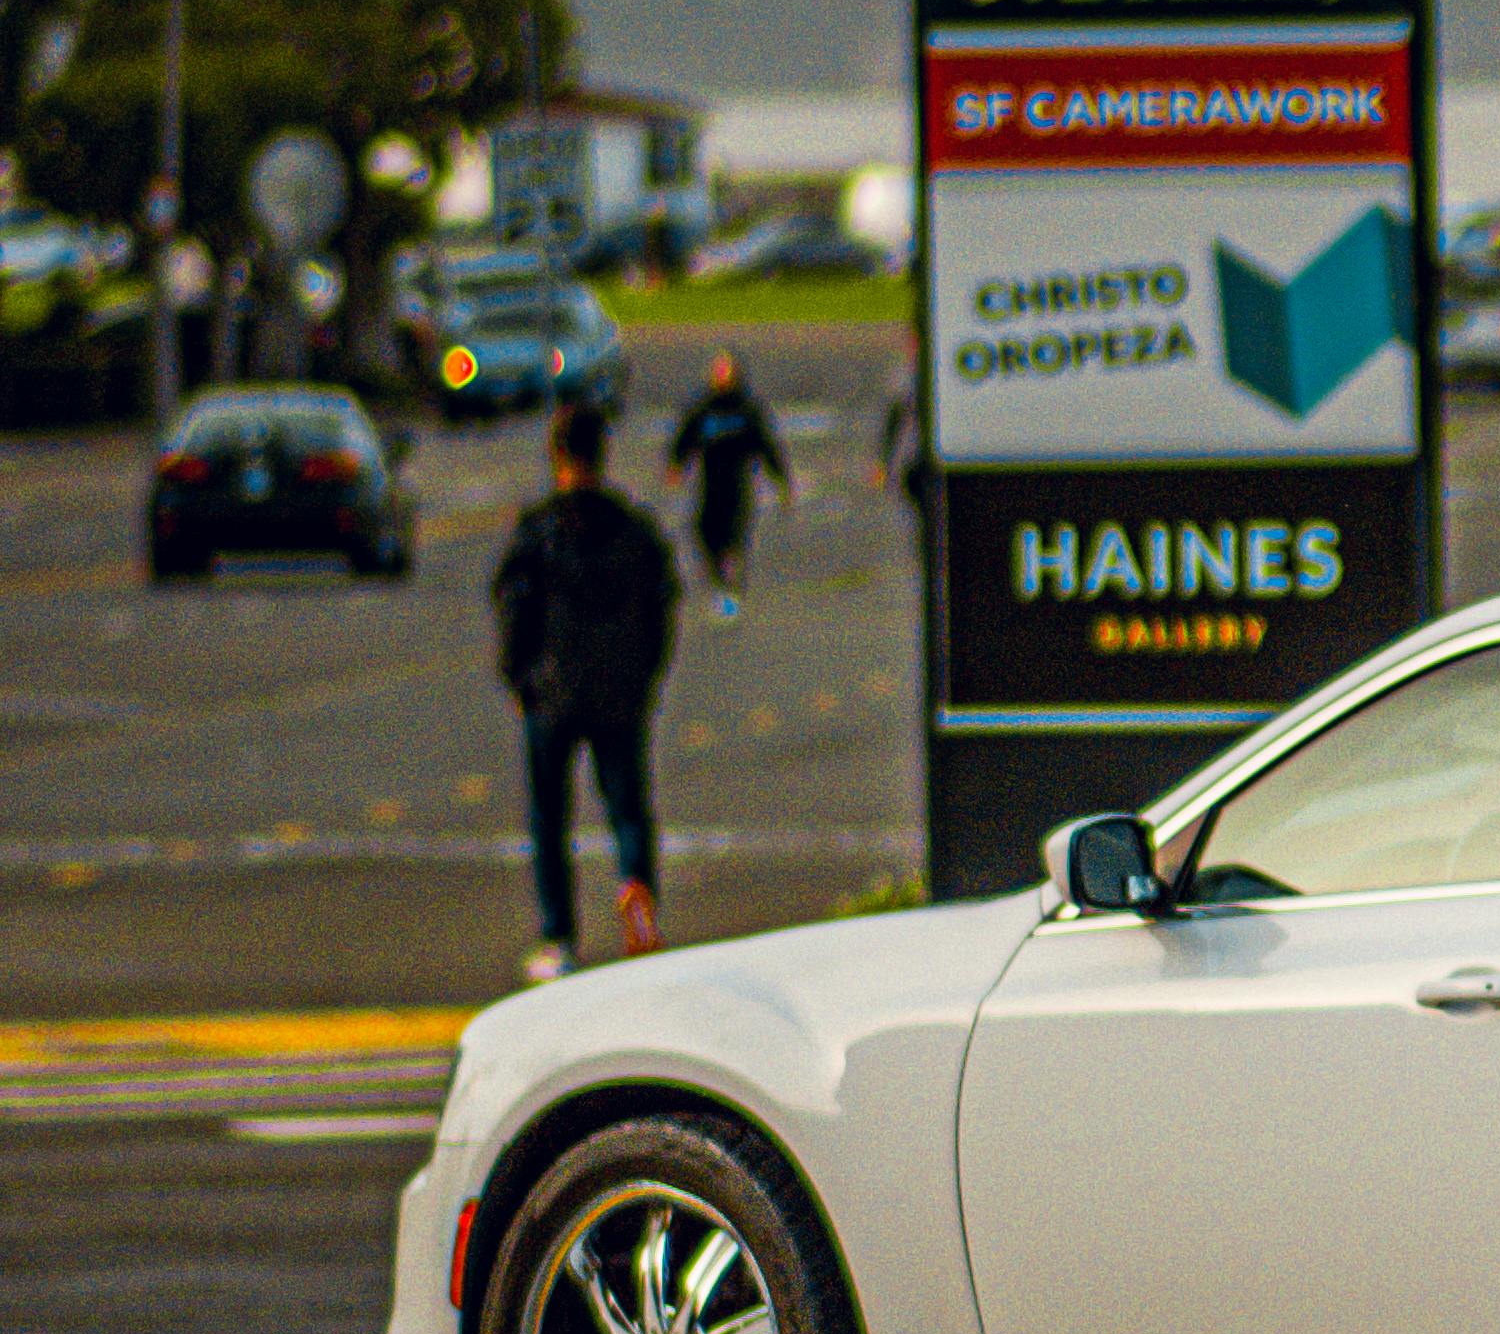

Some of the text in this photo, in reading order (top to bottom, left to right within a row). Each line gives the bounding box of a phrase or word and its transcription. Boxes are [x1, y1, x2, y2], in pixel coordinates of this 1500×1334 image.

[953, 84, 1385, 131] SF CAMERAWORK
[974, 265, 1189, 320] CHRISTO
[955, 322, 1195, 380] OROPEZA
[1020, 524, 1343, 596] HAINES
[1097, 615, 1268, 652] GALLERY
